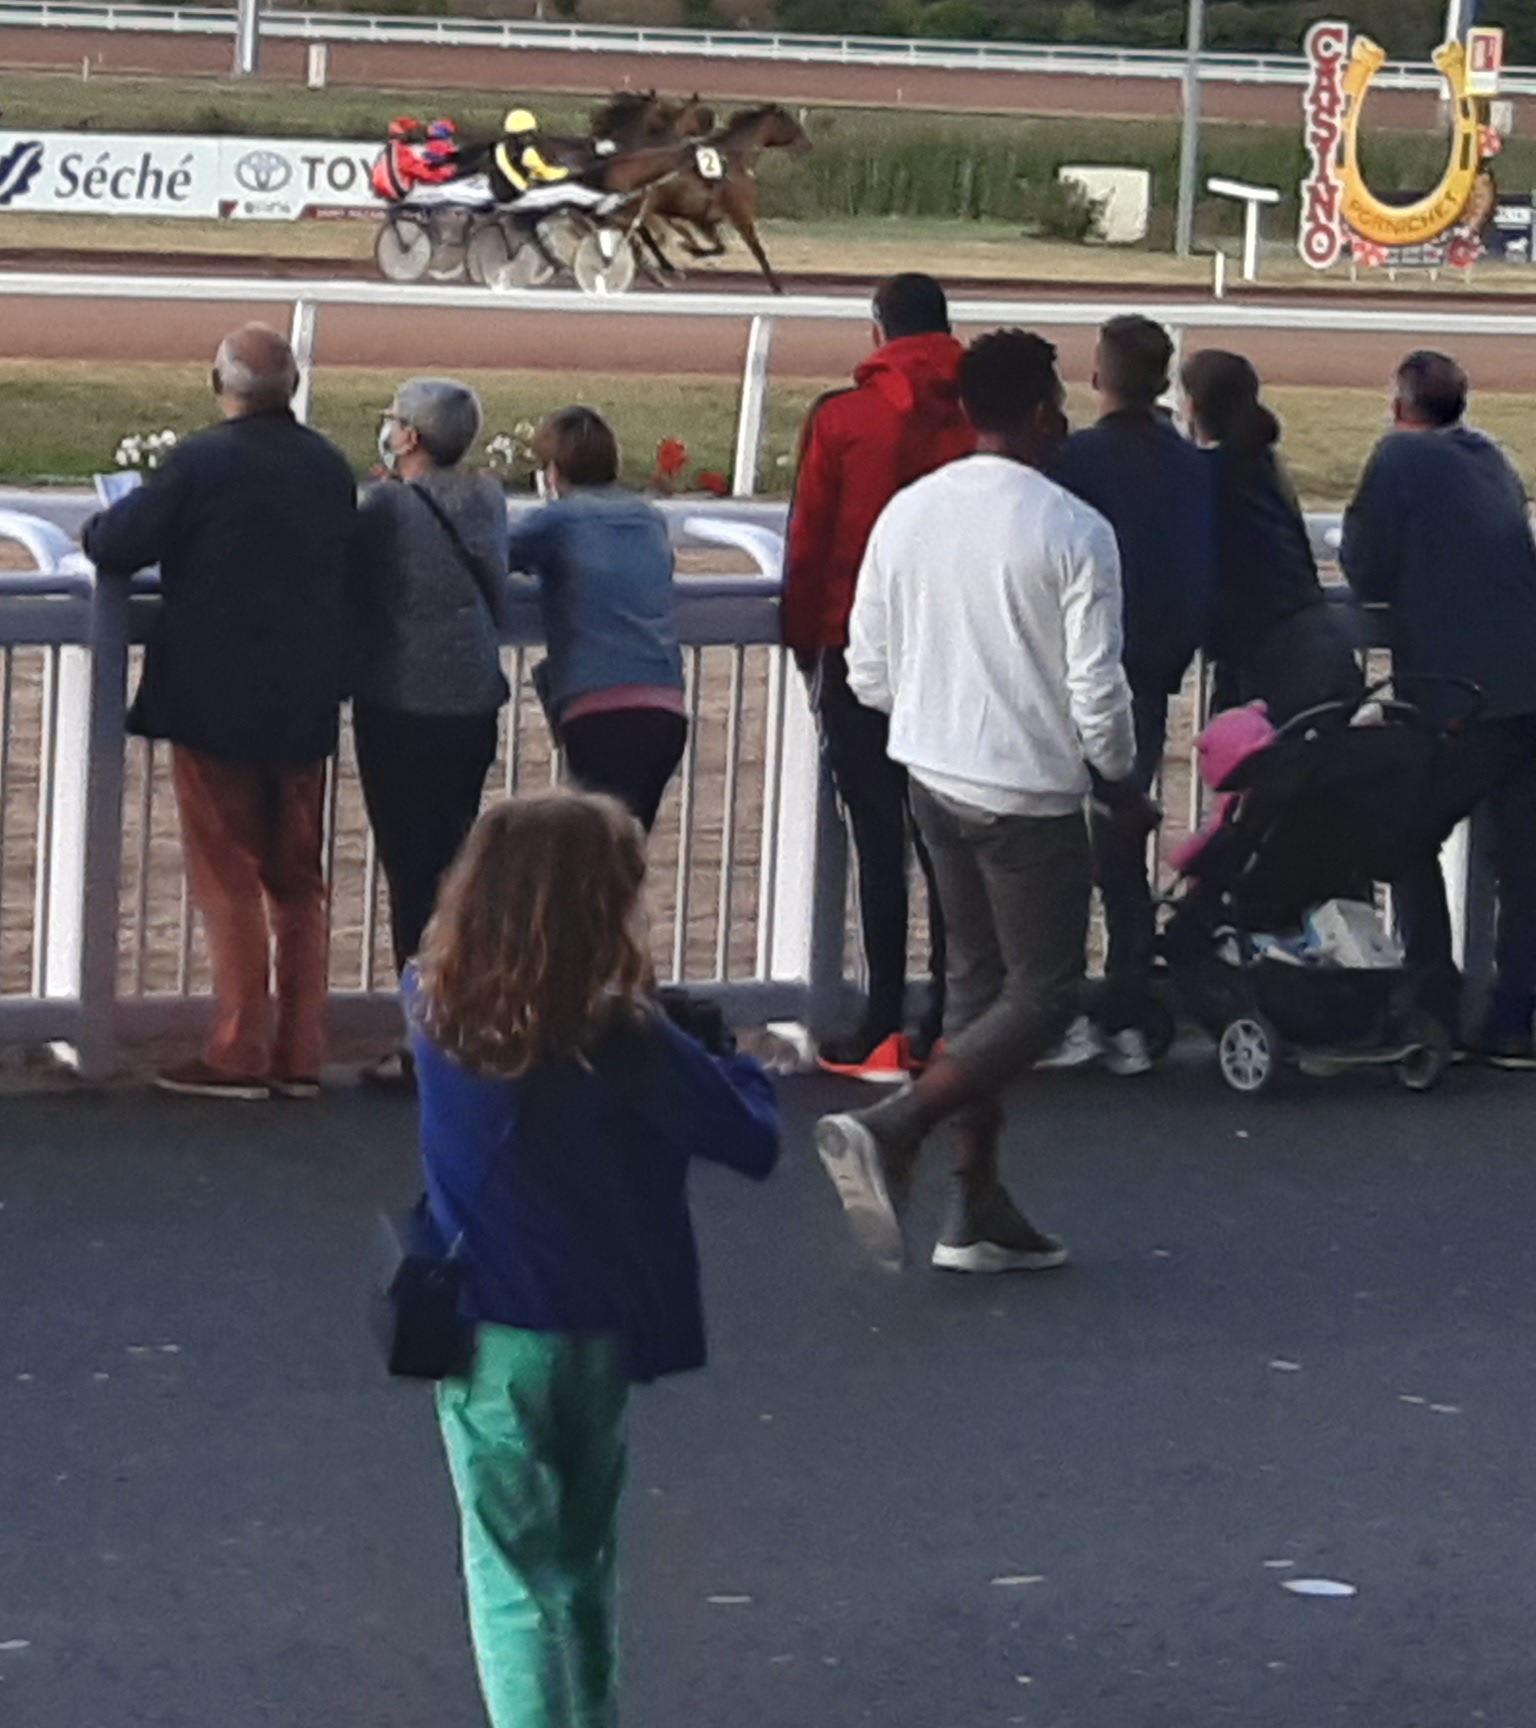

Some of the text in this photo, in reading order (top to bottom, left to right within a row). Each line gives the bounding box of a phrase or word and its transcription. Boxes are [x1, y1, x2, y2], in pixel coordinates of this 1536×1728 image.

[700, 151, 716, 172] 2
[1304, 27, 1344, 263] CASINO
[54, 150, 195, 201] Séché
